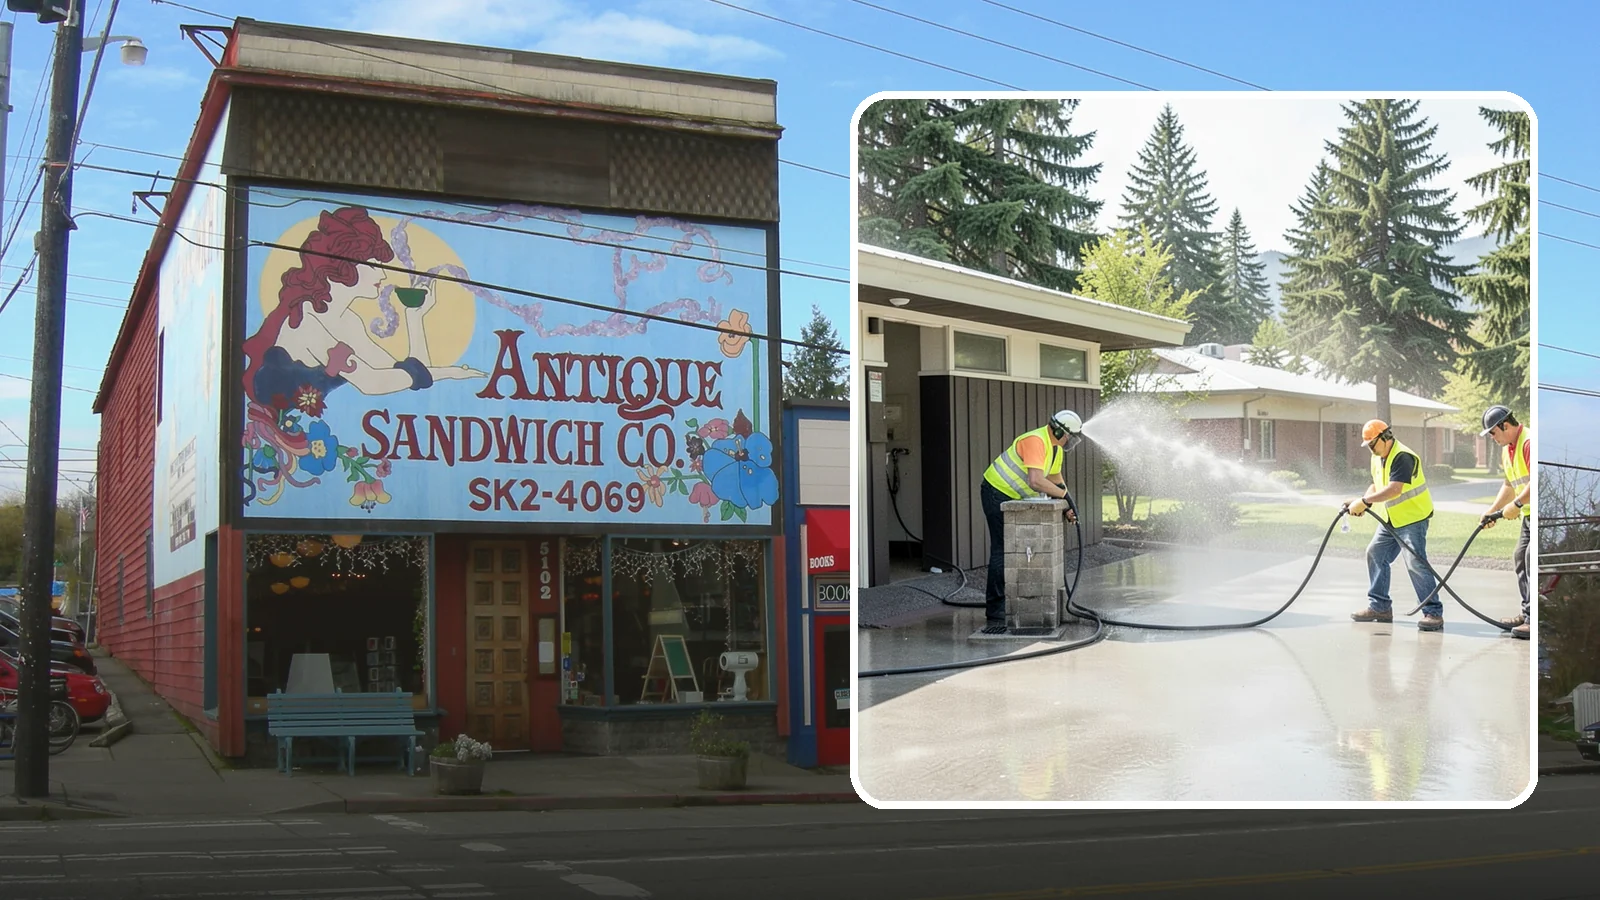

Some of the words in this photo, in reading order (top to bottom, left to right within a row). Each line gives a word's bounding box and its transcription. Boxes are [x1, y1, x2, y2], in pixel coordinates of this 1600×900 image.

[476, 329, 723, 421] ANTIQUE
[361, 408, 605, 467] SANDWICH
[617, 421, 685, 469] CO.
[468, 476, 646, 513] SK2-4069
[540, 542, 551, 599] 5102
[809, 555, 834, 568] BOOKS
